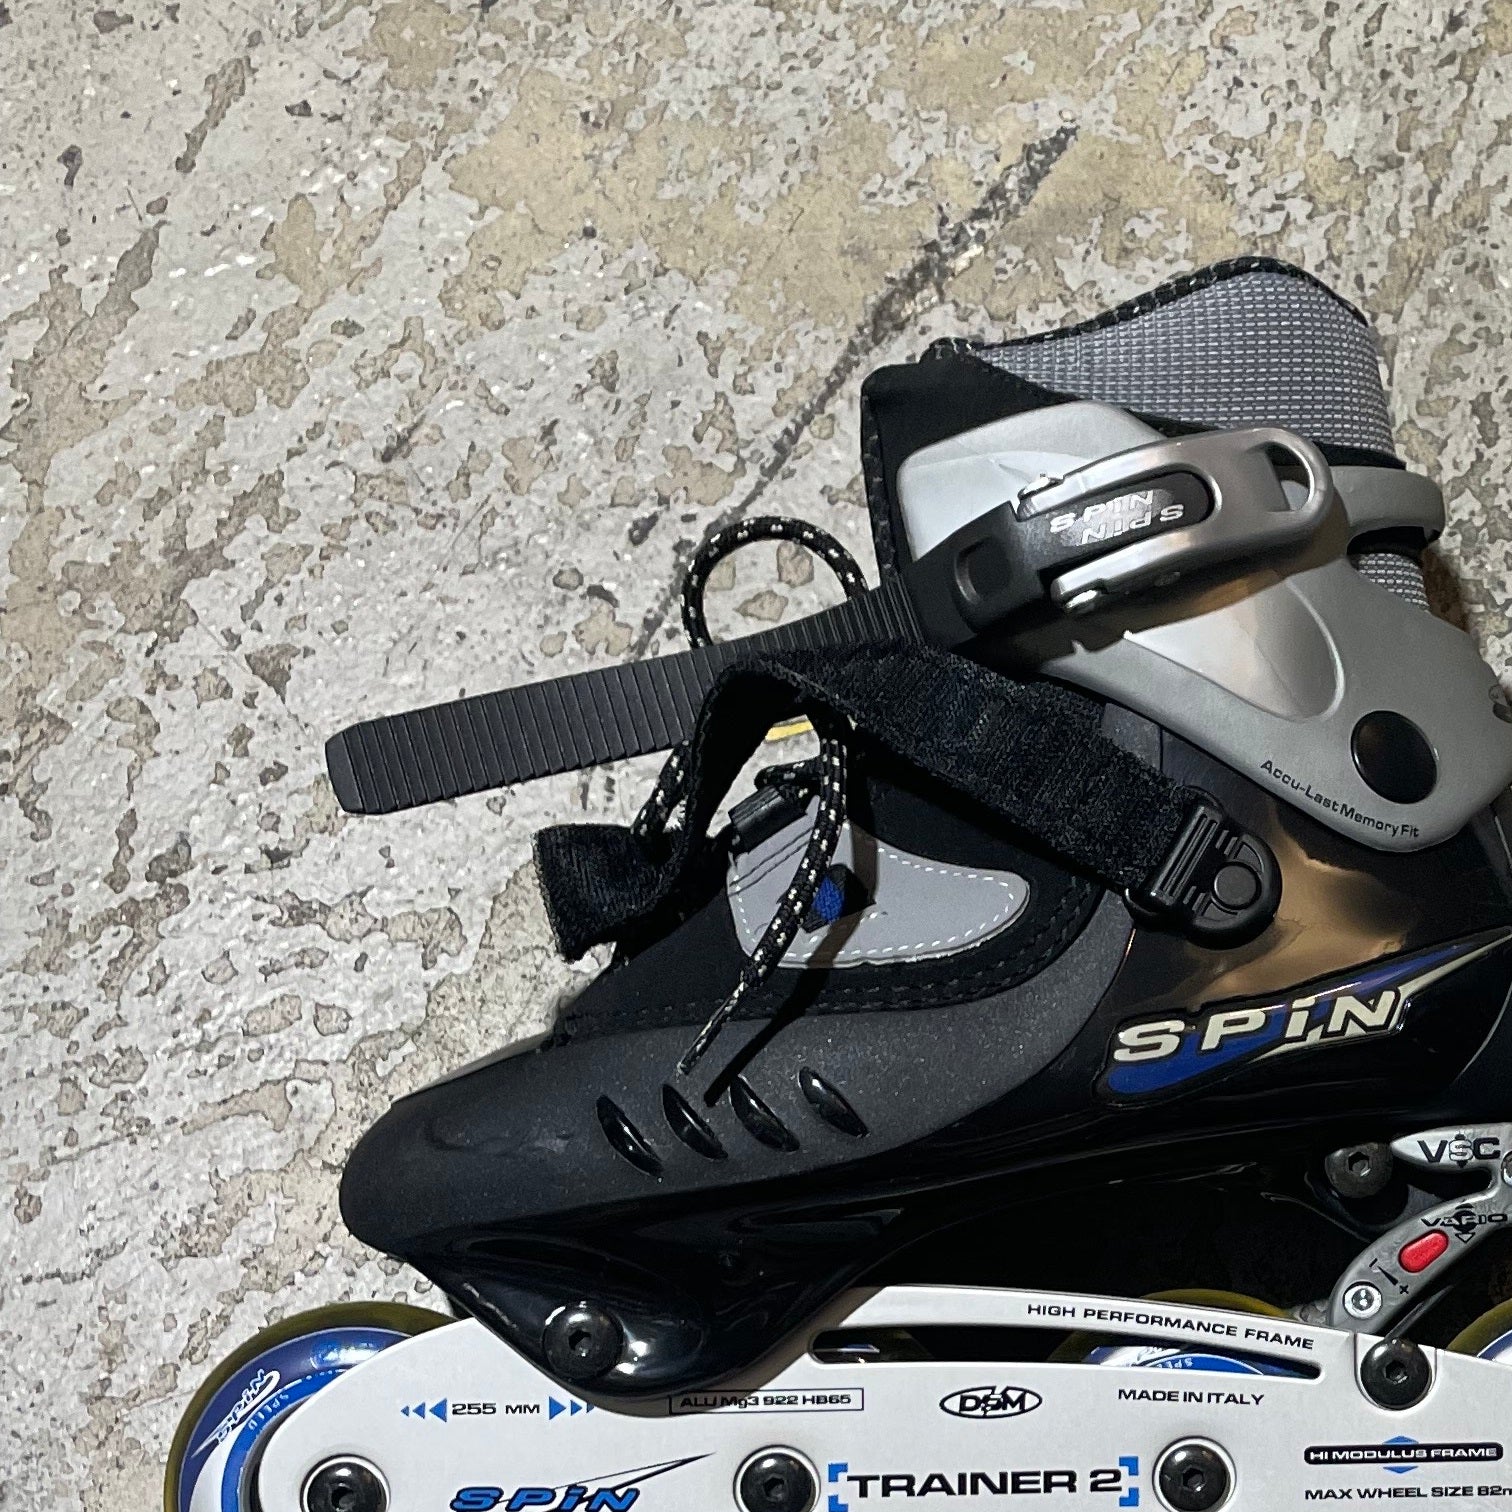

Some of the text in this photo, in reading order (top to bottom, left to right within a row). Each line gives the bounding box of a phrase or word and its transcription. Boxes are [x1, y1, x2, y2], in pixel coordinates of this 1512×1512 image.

[1260, 759, 1420, 838] Accu-Last Memory Fit
[1417, 1137, 1501, 1163] VSC
[1420, 1212, 1509, 1229] VARIO
[1027, 1303, 1315, 1350] HIGH PERFORMANCE FRAME
[720, 1395, 760, 1409] Mg3
[1117, 1388, 1266, 1405] MADE IN ITALY
[451, 1402, 541, 1415] 255 MM
[1309, 1447, 1498, 1460] HI MODULUS FRAME
[846, 1468, 1122, 1498] TRAINER 2
[1304, 1488, 1353, 1500] MAX
[1356, 1487, 1428, 1499] WHEEL
[1431, 1486, 1474, 1498] SIZE
